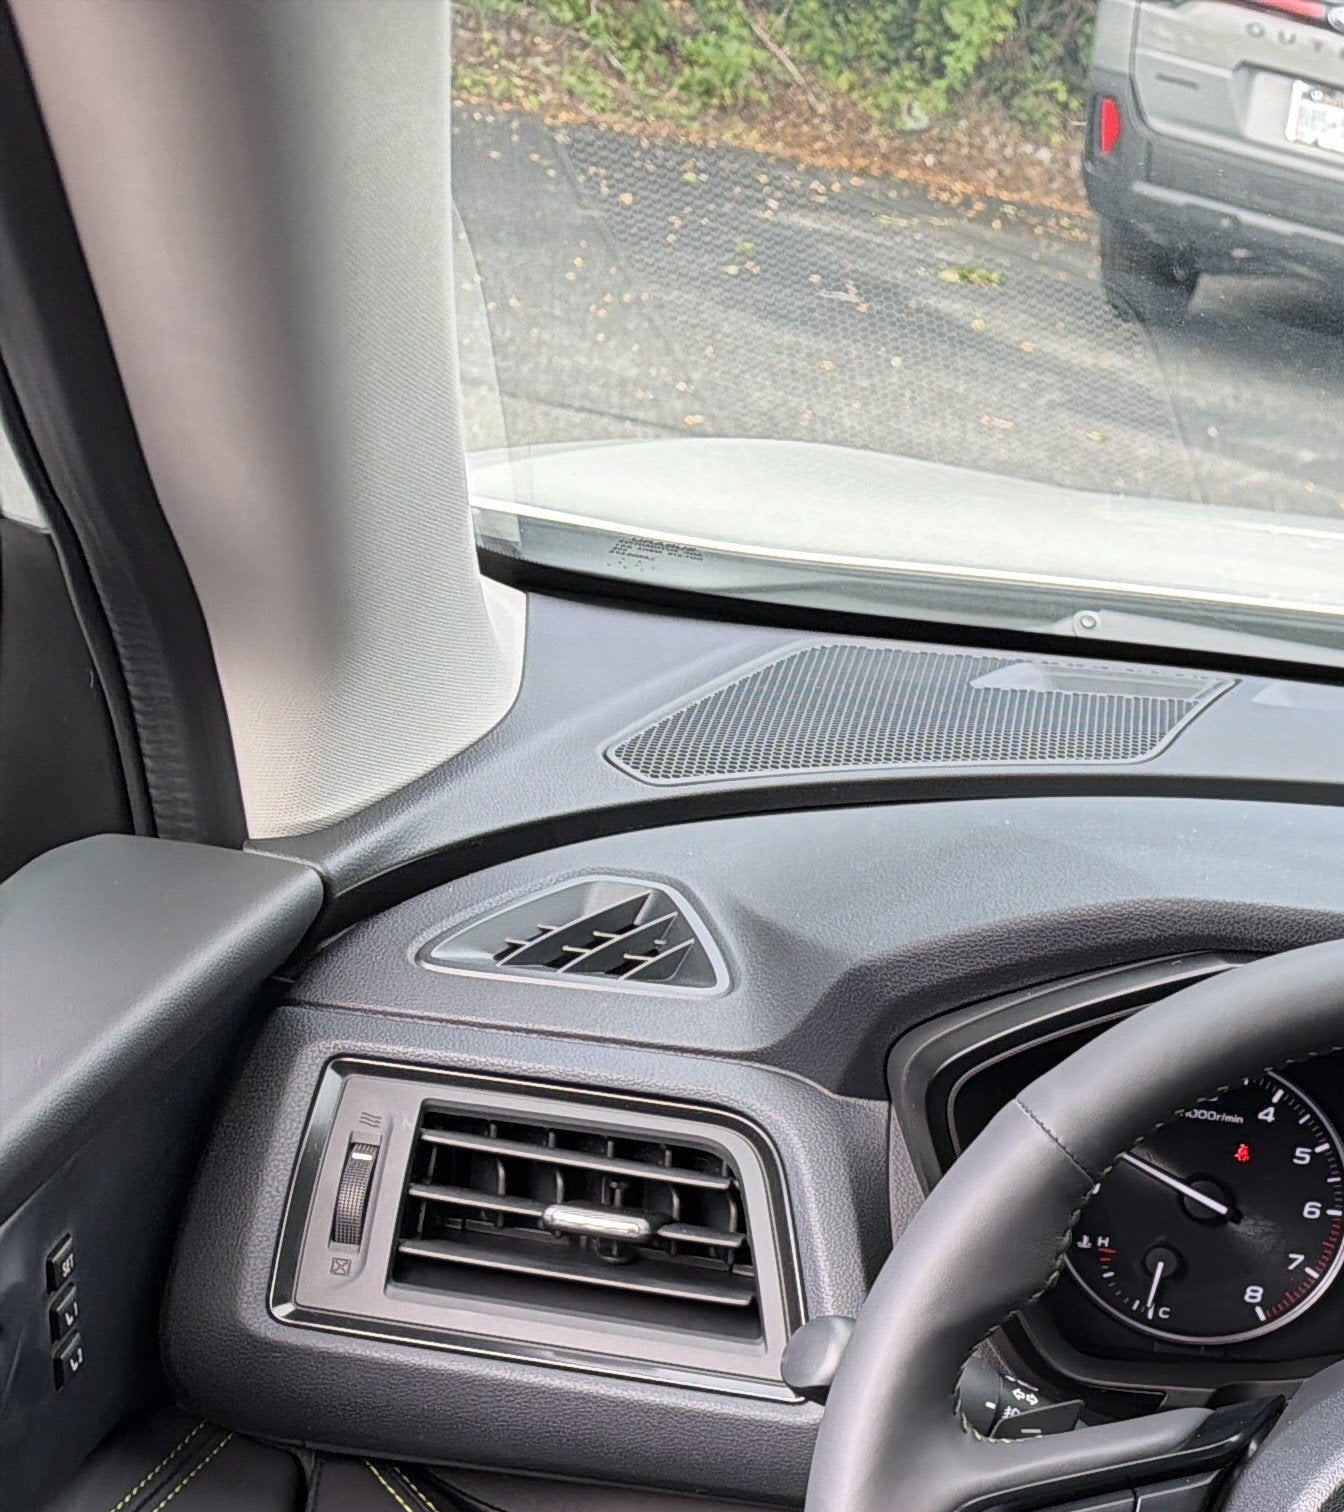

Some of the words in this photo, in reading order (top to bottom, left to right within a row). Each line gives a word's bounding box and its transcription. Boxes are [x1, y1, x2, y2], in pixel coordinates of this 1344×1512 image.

[1257, 1106, 1275, 1122] 4
[1293, 1148, 1312, 1165] 5
[1303, 1202, 1322, 1219] 6
[1097, 1236, 1109, 1247] H
[1287, 1254, 1305, 1271] 7
[1243, 1286, 1263, 1304] 8
[1158, 1307, 1170, 1319] C
